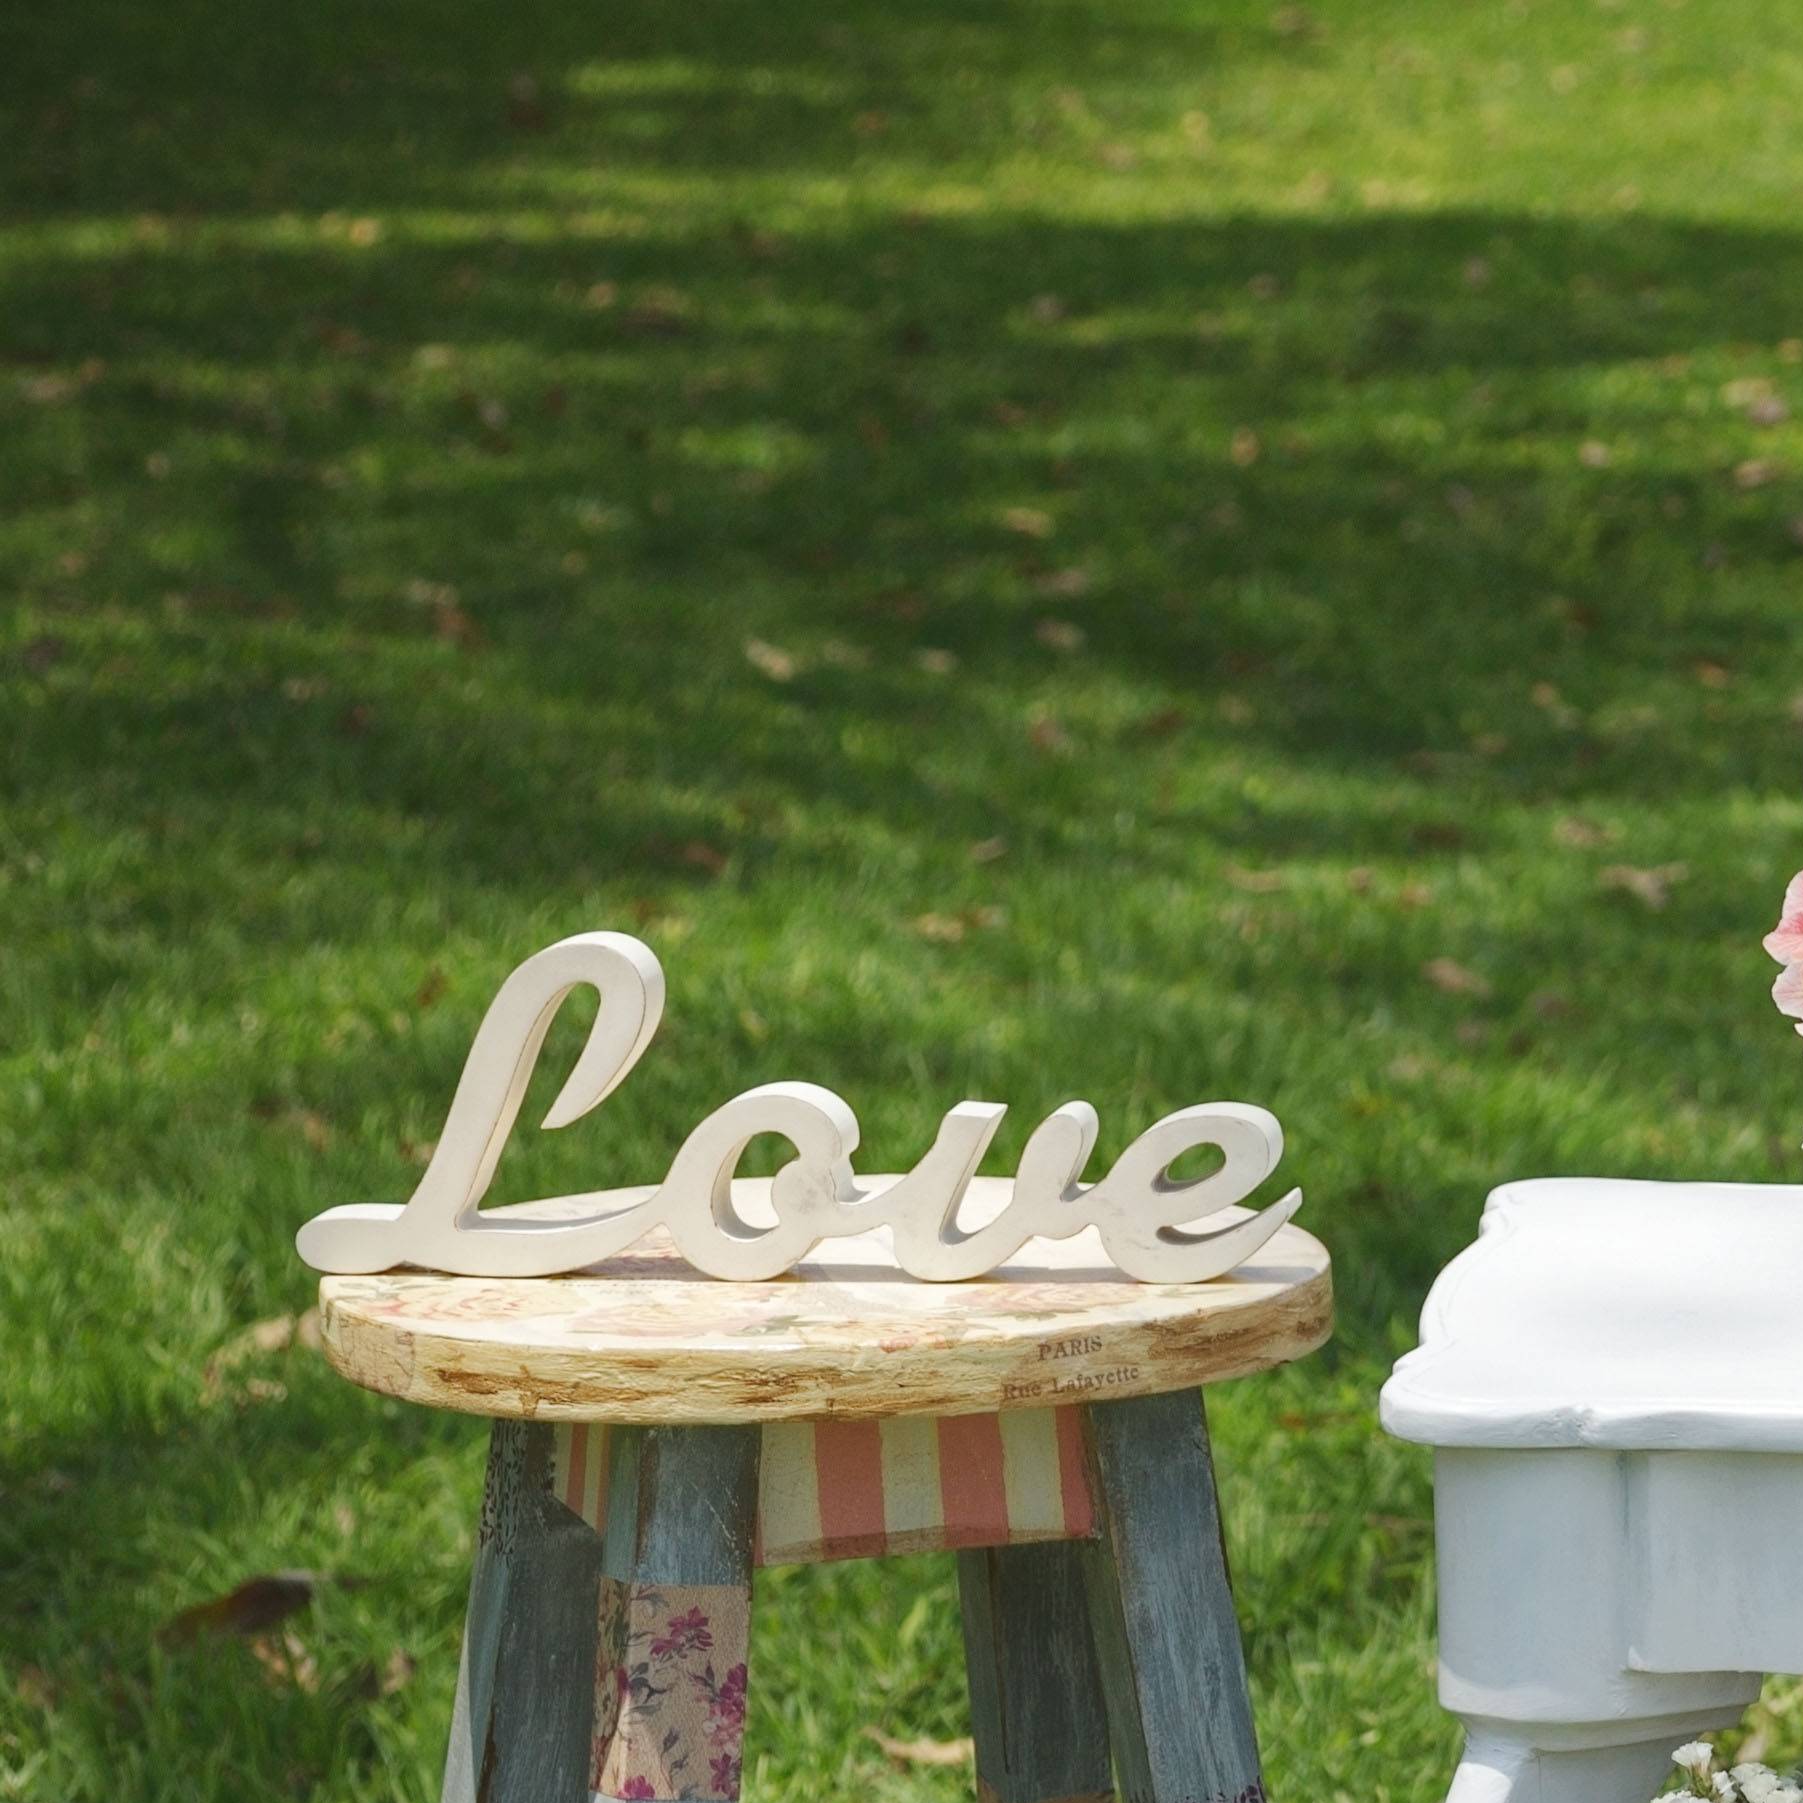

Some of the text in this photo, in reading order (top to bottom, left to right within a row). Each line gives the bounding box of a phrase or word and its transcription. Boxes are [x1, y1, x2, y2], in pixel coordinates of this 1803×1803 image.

[296, 930, 1302, 1284] Love
[1037, 1335, 1103, 1362] PARIS
[1002, 1366, 1139, 1400] Rue Lafayette
